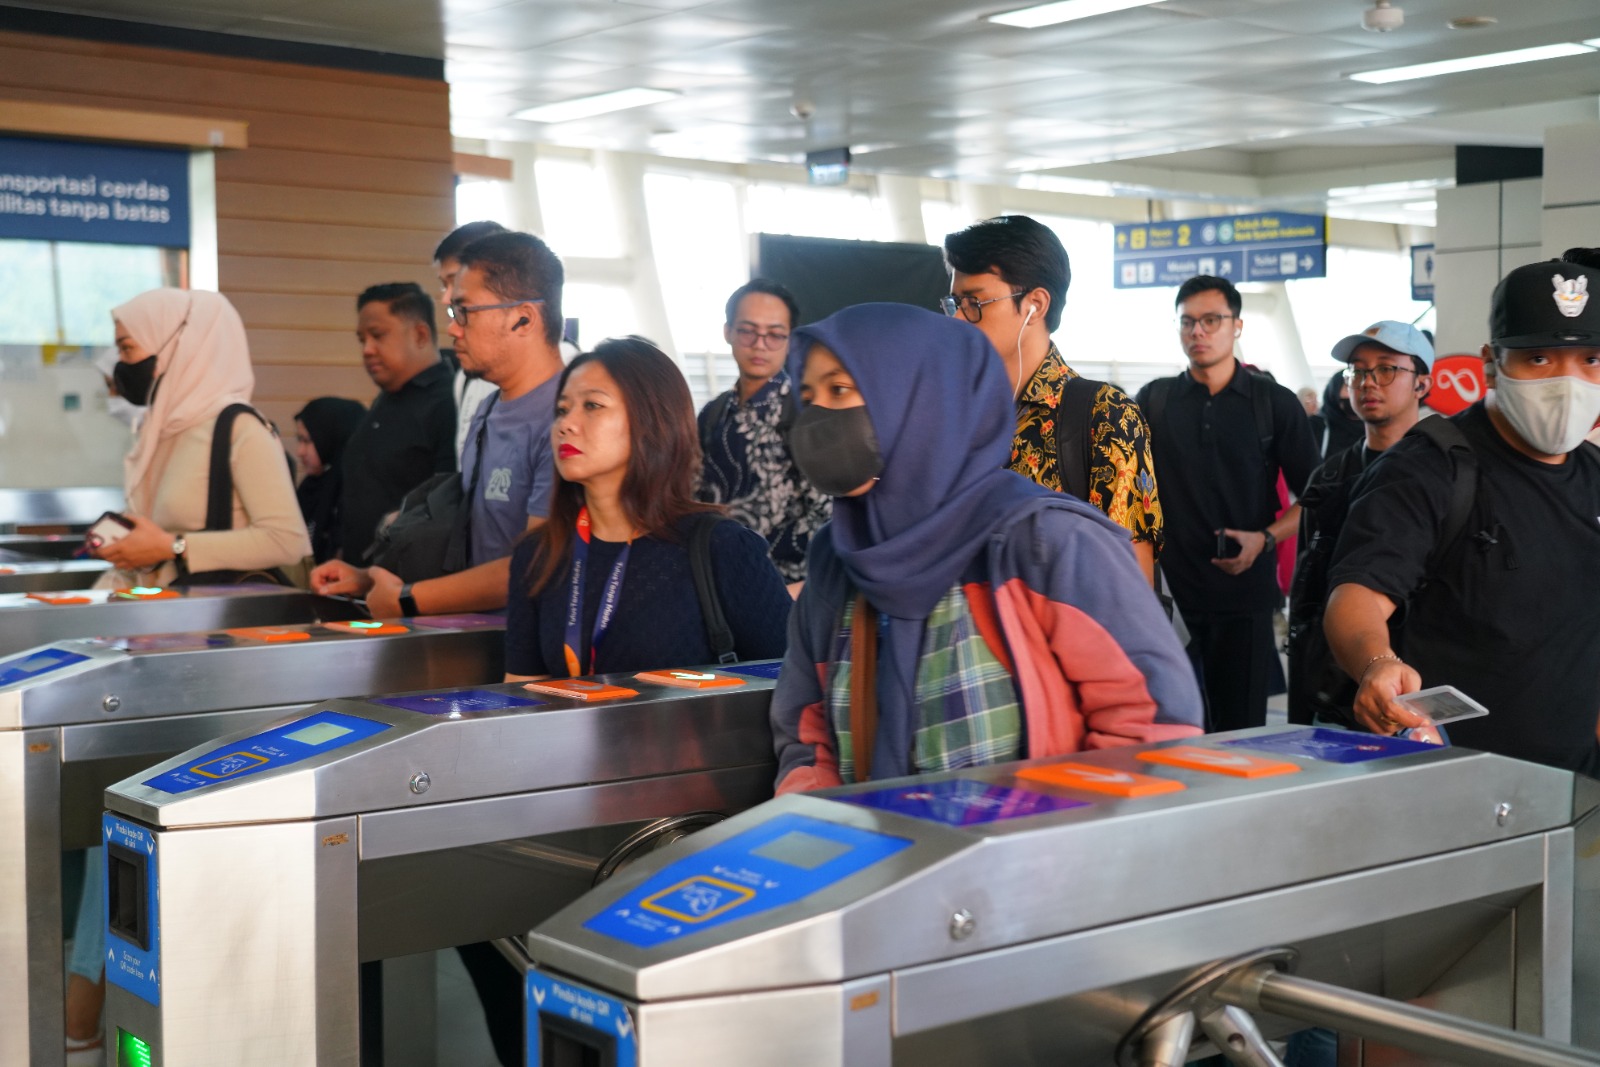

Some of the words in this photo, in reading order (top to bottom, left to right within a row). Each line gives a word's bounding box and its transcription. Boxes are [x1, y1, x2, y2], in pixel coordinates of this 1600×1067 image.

[0, 174, 96, 196] nsportasi
[100, 178, 169, 201] cerdas
[50, 197, 109, 222] tanpa
[113, 200, 170, 223] batas
[1177, 223, 1191, 247] 2
